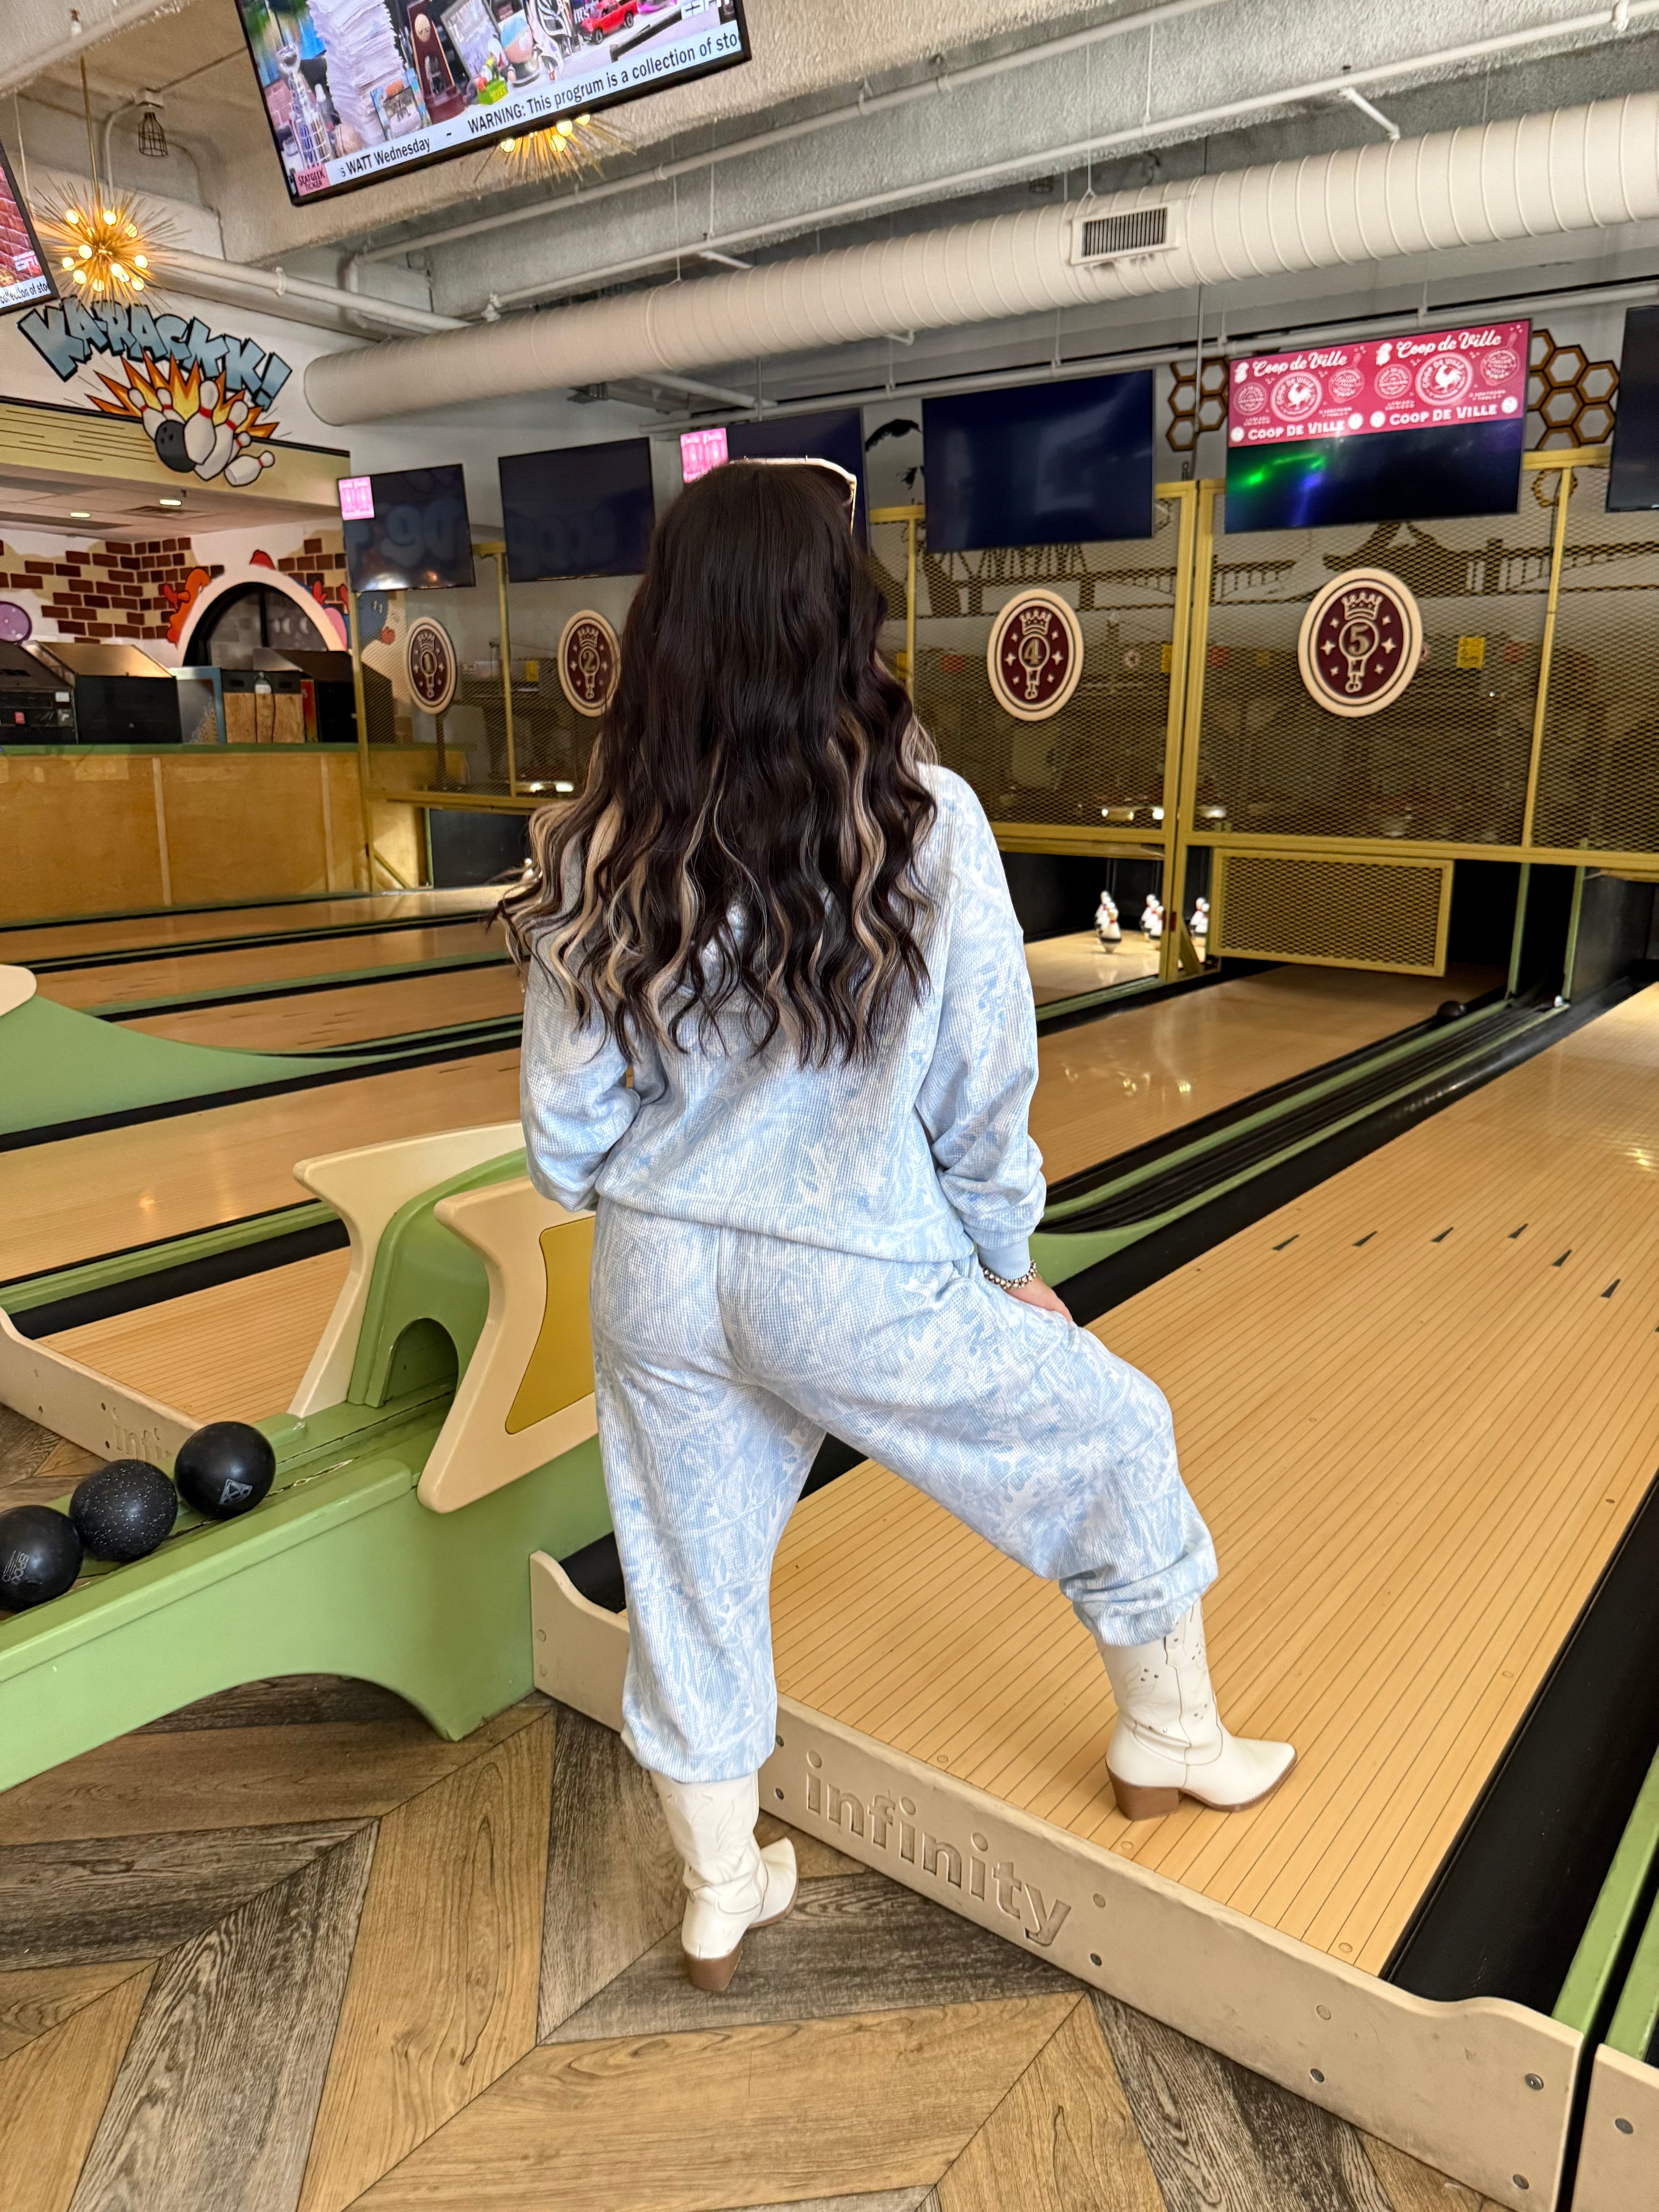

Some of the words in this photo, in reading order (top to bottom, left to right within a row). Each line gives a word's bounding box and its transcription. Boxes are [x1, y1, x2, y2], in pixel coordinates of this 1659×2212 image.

[346, 154, 372, 175] WATT
[373, 138, 431, 165] Wednesday
[467, 103, 526, 134] WARNING:
[526, 95, 552, 115] This
[554, 79, 604, 109] progrum
[607, 73, 618, 88] is
[622, 70, 629, 83] a
[632, 48, 696, 79] collection
[700, 37, 712, 57] of
[717, 33, 737, 51] sto
[29, 282, 37, 295] of
[1396, 340, 1437, 358] Coop
[1438, 335, 1457, 351] de
[1458, 329, 1502, 350] Ville
[1252, 360, 1288, 377] Coop
[1290, 355, 1307, 370] de
[1308, 350, 1348, 369] Ville
[1389, 411, 1430, 425] COOP
[1432, 409, 1452, 422] DE
[1456, 404, 1498, 419] VILLE
[1248, 427, 1284, 440] COOP
[1286, 424, 1304, 436] DE
[1307, 420, 1346, 434] VILLE
[1023, 639, 1042, 665] 4
[1348, 625, 1370, 655] 5
[583, 650, 596, 672] 2
[806, 1749, 1071, 1947] infinity
